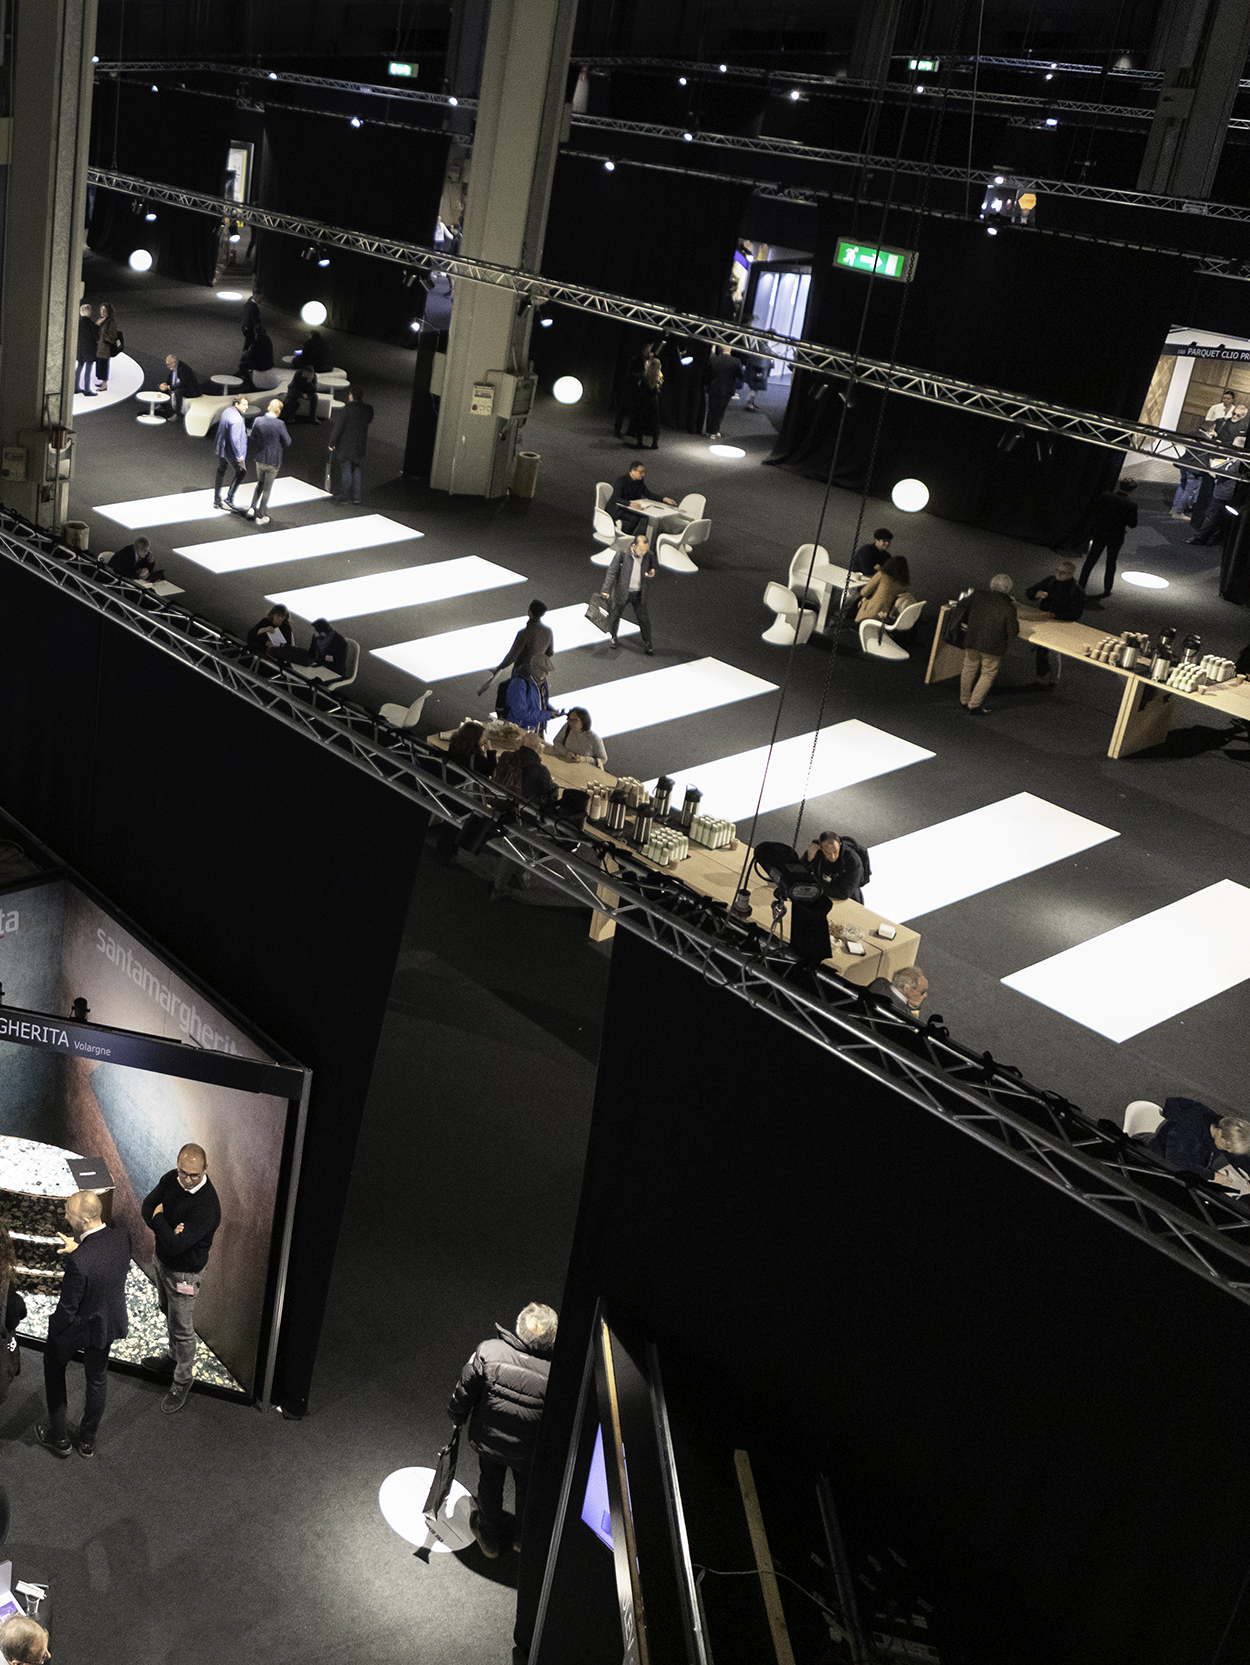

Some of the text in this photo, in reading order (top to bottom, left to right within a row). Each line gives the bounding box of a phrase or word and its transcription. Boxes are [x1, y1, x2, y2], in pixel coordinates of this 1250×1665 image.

[1187, 347, 1220, 358] PARQUET
[1221, 350, 1239, 360] CLIO
[74, 1040, 111, 1057] Volargne
